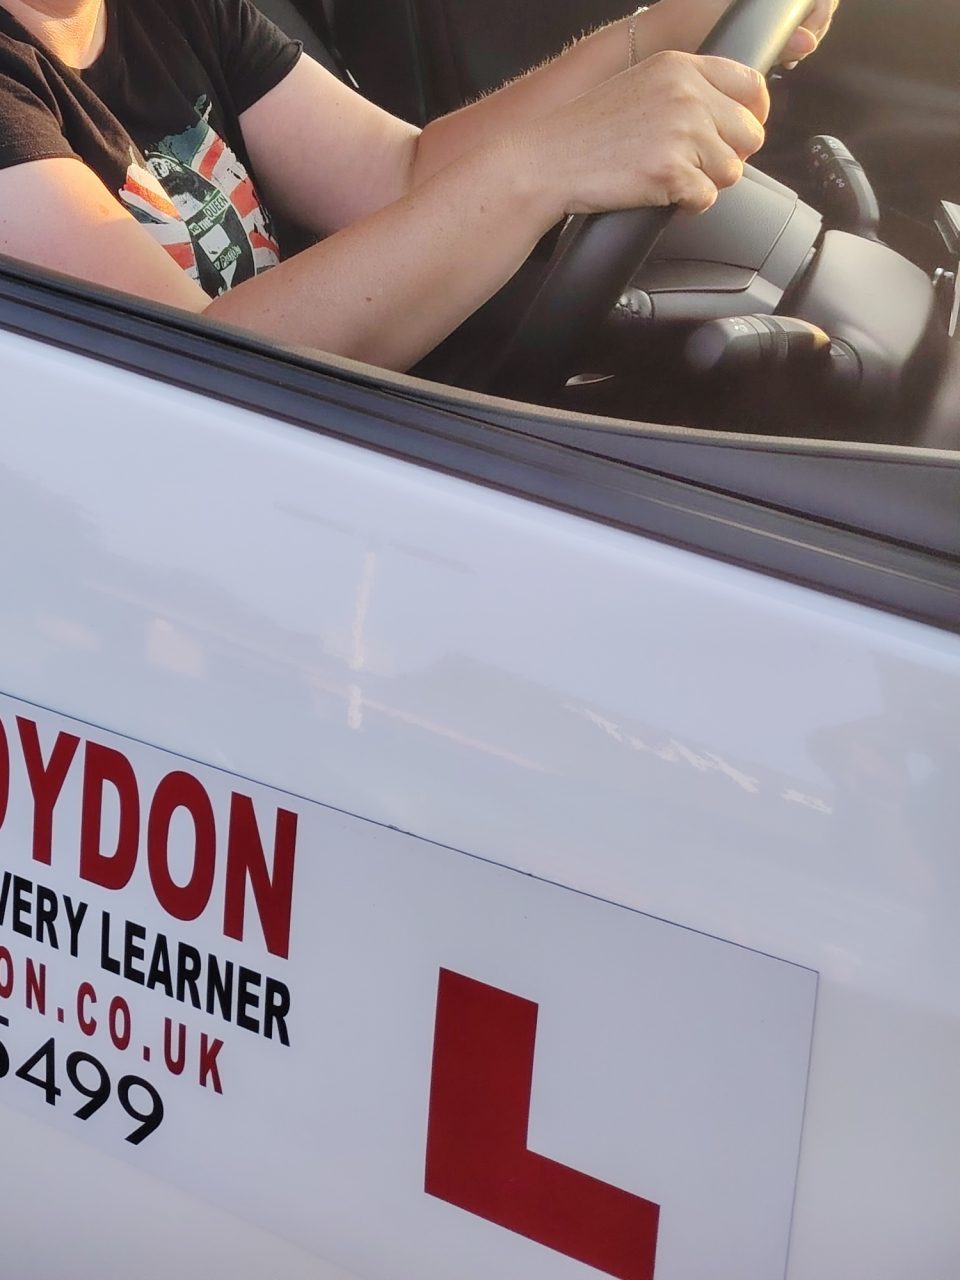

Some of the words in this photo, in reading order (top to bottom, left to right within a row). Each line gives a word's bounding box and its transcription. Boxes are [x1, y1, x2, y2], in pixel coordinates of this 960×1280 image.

[204, 193, 228, 218] QUEEN
[100, 911, 290, 1047] LEARNER
[424, 966, 660, 1280] L
